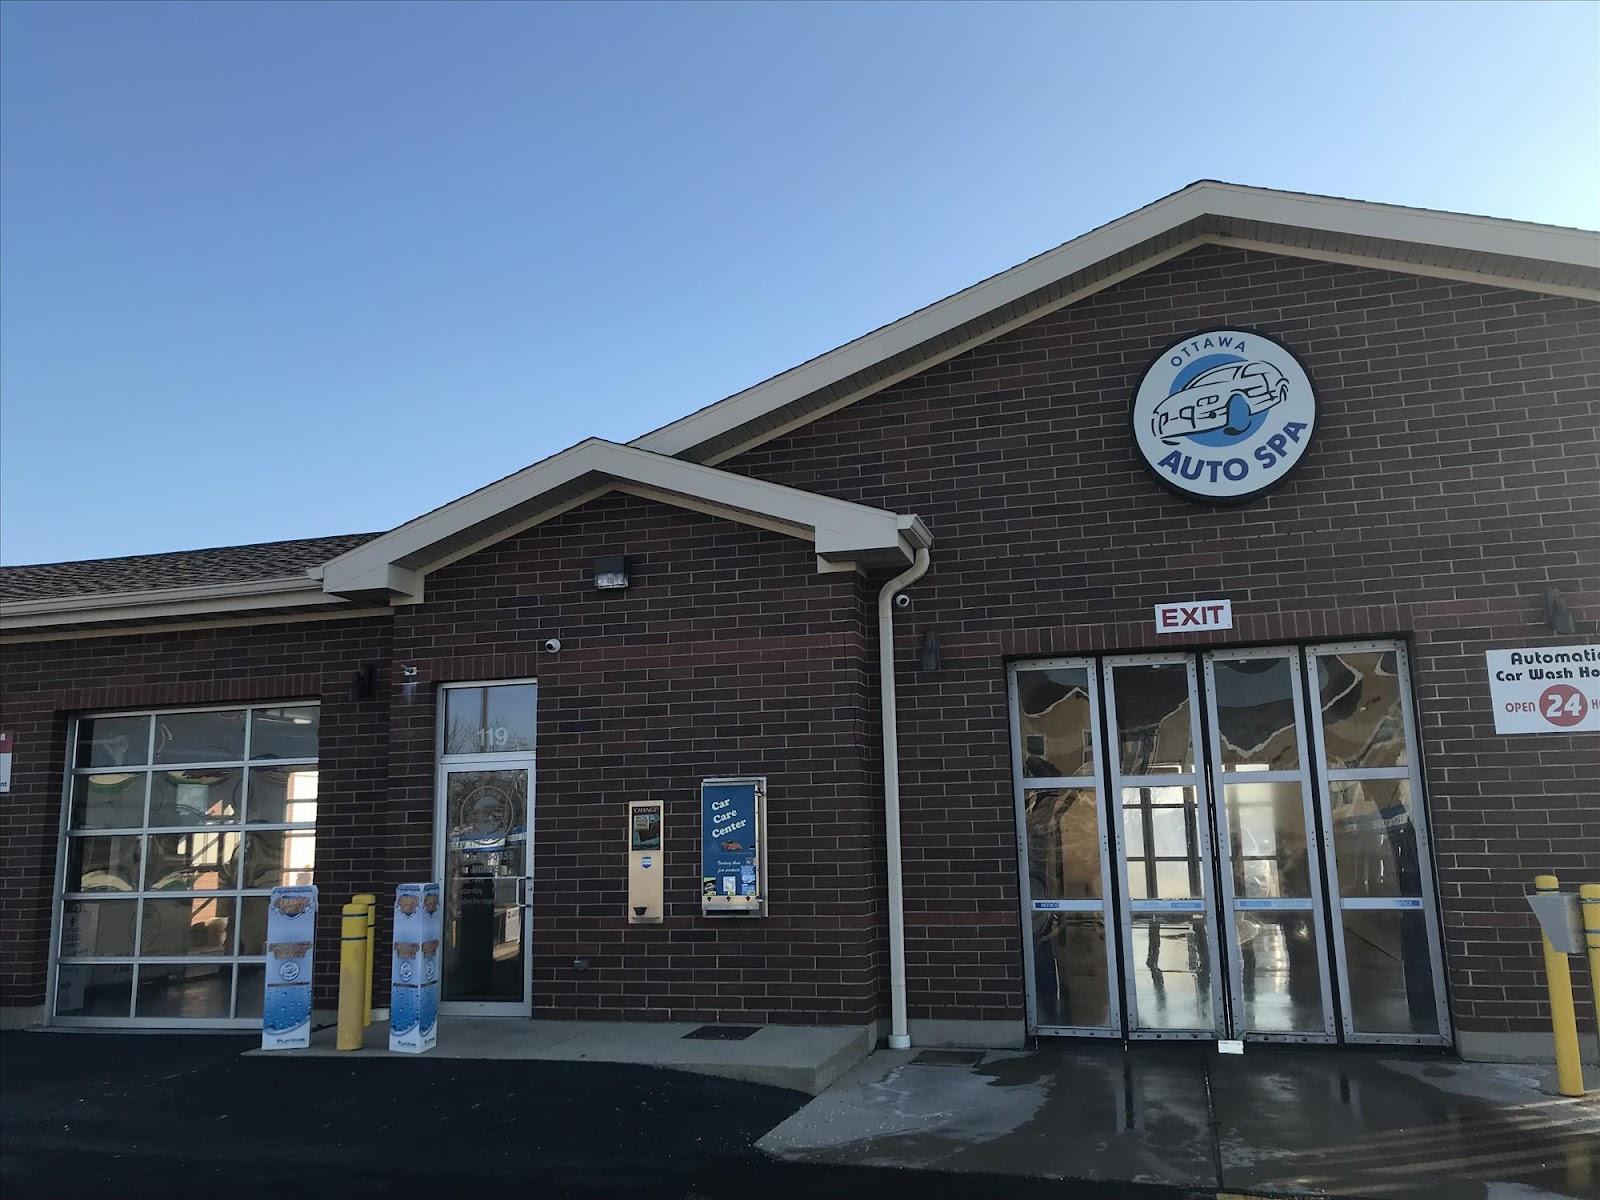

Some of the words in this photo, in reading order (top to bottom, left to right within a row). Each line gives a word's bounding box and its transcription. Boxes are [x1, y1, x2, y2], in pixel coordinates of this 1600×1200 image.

[1171, 336, 1246, 366] OTTAWA
[1157, 449, 1249, 483] AUTO
[1254, 421, 1308, 470] SPA
[1161, 605, 1225, 628] EXIT
[1496, 670, 1523, 681] Car
[1528, 667, 1574, 681] Wash
[1505, 702, 1536, 713] OPEN
[1546, 693, 1582, 718] 24
[476, 727, 508, 746] 119
[711, 798, 731, 811] Car
[713, 809, 738, 824] Care
[711, 818, 747, 838] Center
